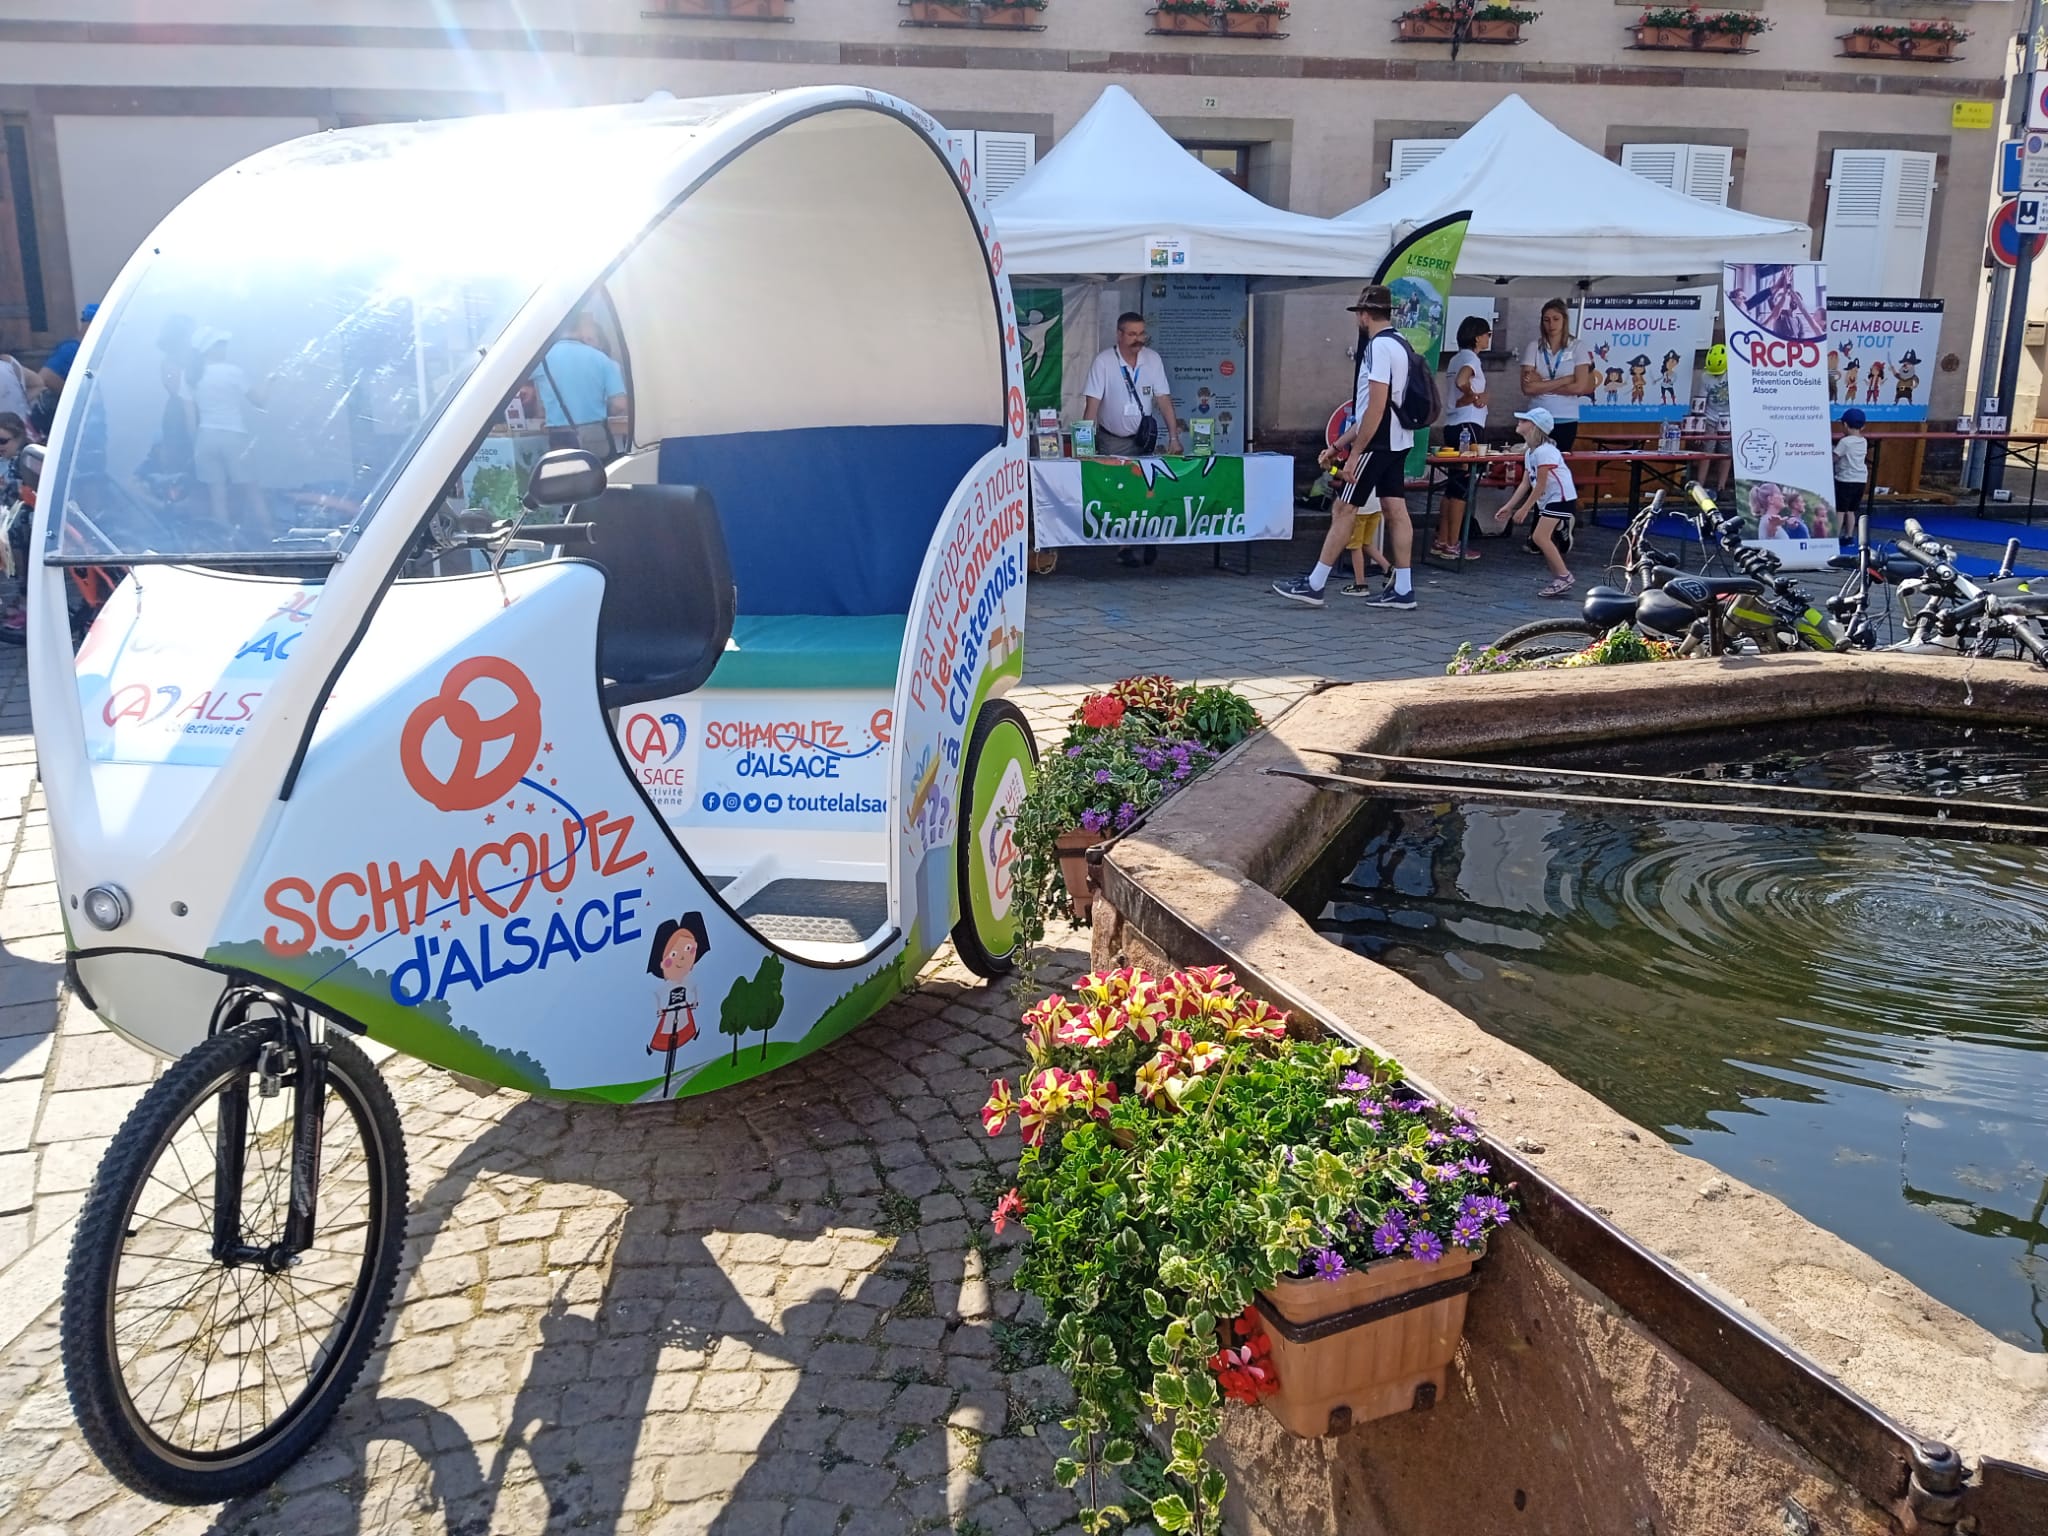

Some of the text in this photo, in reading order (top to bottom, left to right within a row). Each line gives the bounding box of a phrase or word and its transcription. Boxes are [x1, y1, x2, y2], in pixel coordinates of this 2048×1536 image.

[1206, 98, 1215, 106] 72
[1407, 254, 1452, 272] L'ESPRIT
[1583, 317, 1680, 331] CHAMBOULE-
[1830, 319, 1924, 333] CHAMBOULE-
[1611, 333, 1651, 347] TOUT
[1856, 335, 1895, 348] TOUT
[1752, 369, 1803, 377] Réseau Cardio
[1752, 377, 1822, 386] Prévention Obésité
[1084, 496, 1245, 540] Station Verte
[911, 507, 975, 712] Participez
[986, 458, 1025, 512] notre
[942, 737, 961, 769] à
[736, 751, 841, 779] d'ALSACE
[390, 889, 643, 1007] d'ALSACE
